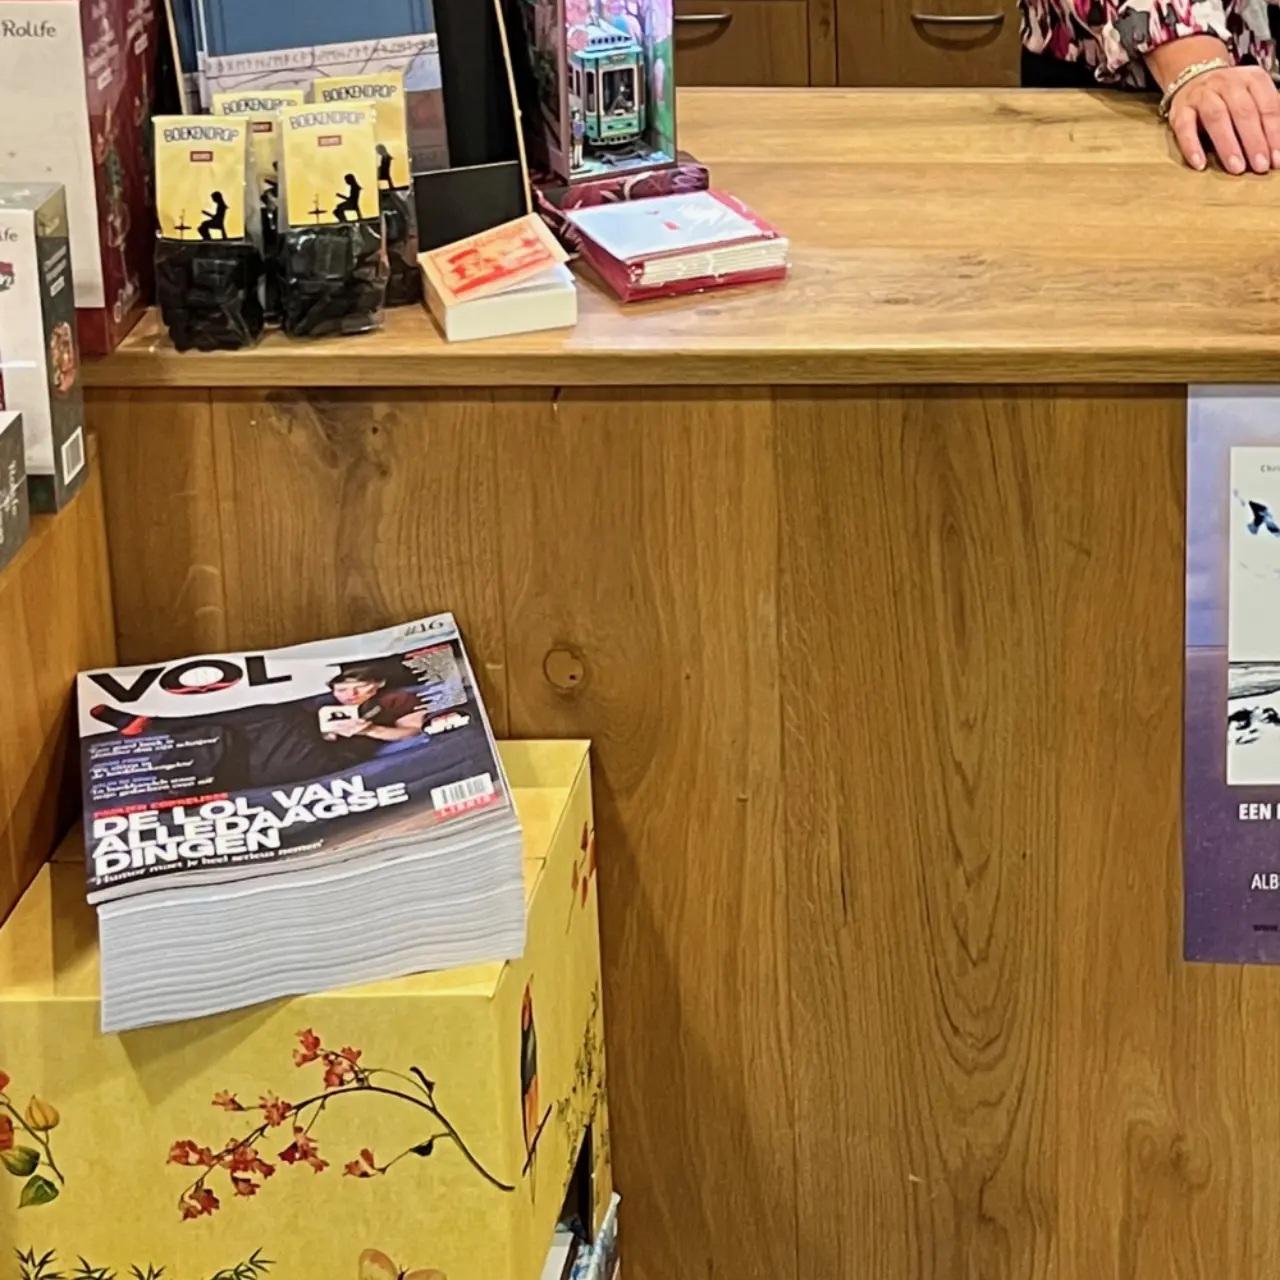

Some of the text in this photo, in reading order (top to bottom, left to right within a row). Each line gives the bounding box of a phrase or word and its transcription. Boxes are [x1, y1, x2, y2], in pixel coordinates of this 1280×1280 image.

[2, 20, 56, 37] Rolife
[323, 85, 396, 102] BOEKENDROP
[222, 96, 298, 115] BOEKENDRO
[290, 111, 365, 129] BOEKENDROP
[164, 127, 240, 142] BOEKENDROP
[402, 619, 445, 637] #16
[88, 656, 293, 703] VOL
[93, 774, 368, 839] DE LOL VAN
[1239, 803, 1271, 821] EEN
[92, 782, 409, 858] ALLEDAAGSE
[95, 828, 281, 876] DINGEN
